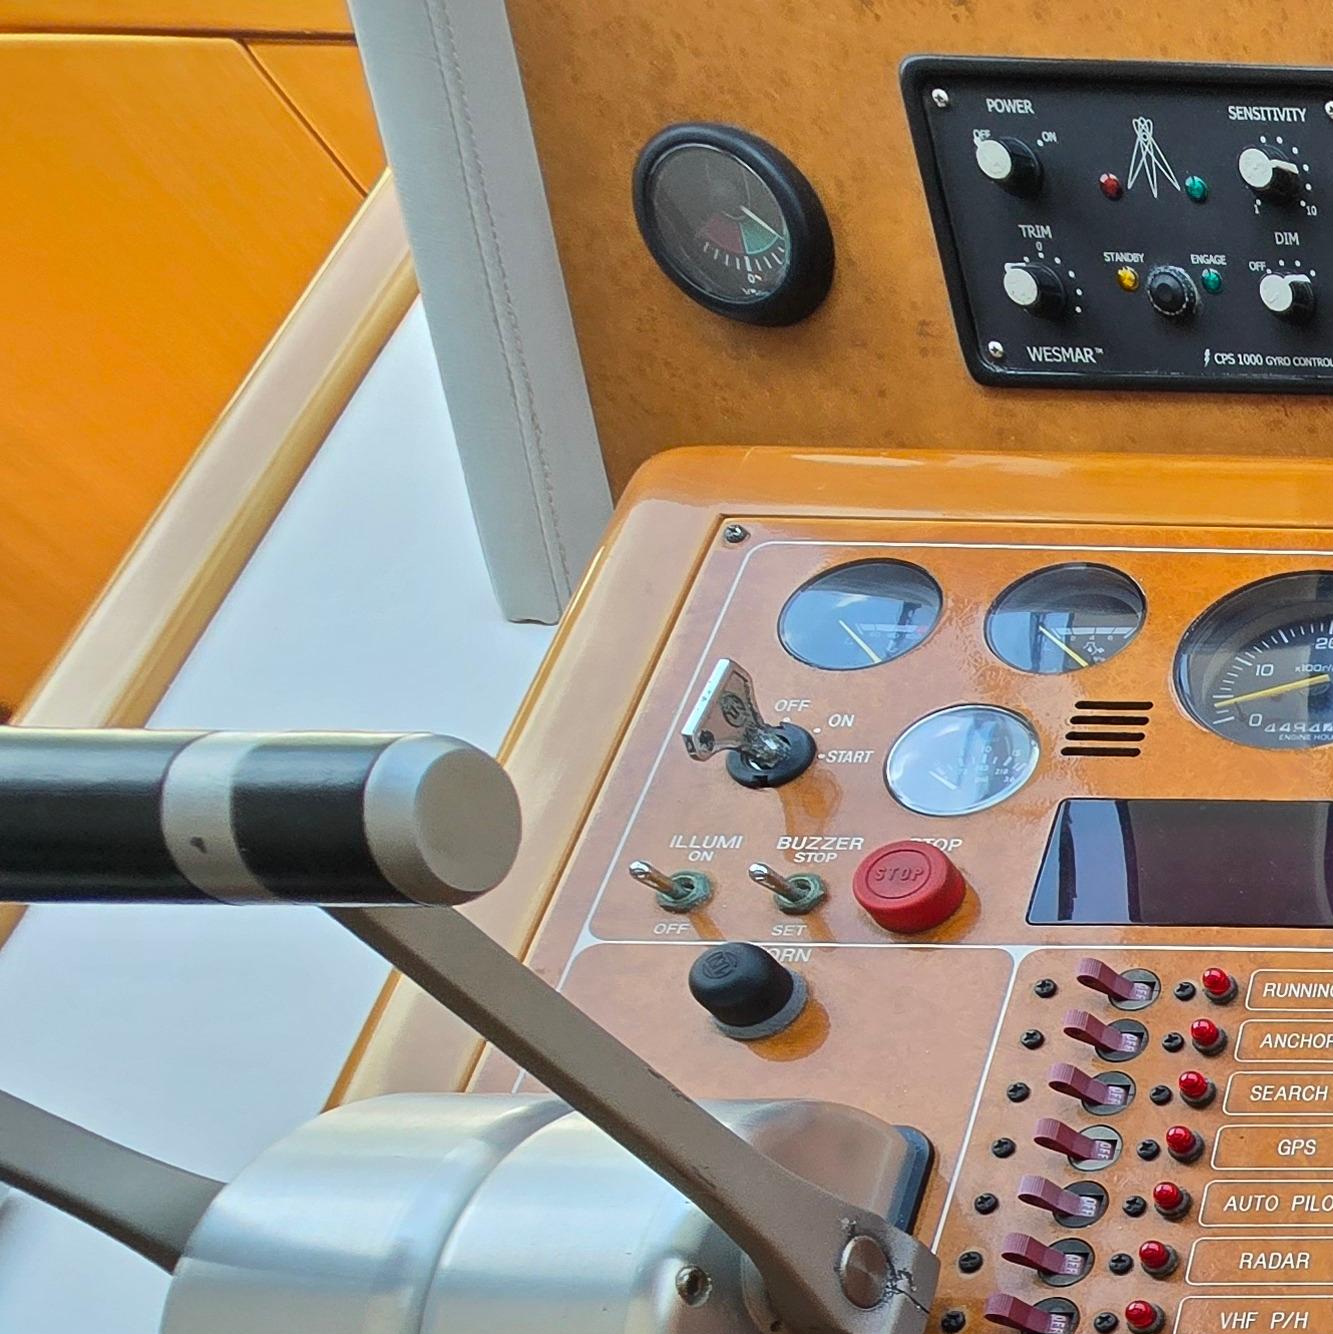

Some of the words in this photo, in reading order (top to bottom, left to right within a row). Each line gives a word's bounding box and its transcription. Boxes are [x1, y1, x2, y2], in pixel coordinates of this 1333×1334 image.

[986, 98, 1035, 115] POWER
[1228, 106, 1306, 122] SENSITIVITY
[1041, 131, 1058, 144] ON
[1306, 205, 1317, 216] 10
[1018, 224, 1052, 239] TRIM
[1274, 232, 1299, 246] DIM
[1103, 251, 1144, 263] STANDBY
[1190, 254, 1227, 266] ENGAGE
[1248, 261, 1266, 272] OFF
[1214, 353, 1236, 365] CPS
[1237, 353, 1263, 366] 1000
[1265, 356, 1291, 367] GYRO
[1255, 664, 1274, 677] 10
[774, 700, 811, 712] OFF
[828, 714, 855, 727] ON
[826, 750, 874, 763] START
[669, 836, 743, 849] ILLUMI
[776, 837, 864, 850] BUZZER
[688, 851, 714, 862] ON
[793, 852, 838, 863] STOP
[875, 866, 924, 882] STOP
[653, 924, 690, 935] OFF
[771, 925, 807, 936] SET
[768, 948, 811, 962] ORN
[1250, 1085, 1327, 1101] SEARCH
[1277, 1139, 1316, 1156] GPS
[1223, 1195, 1279, 1212] AUTO
[1239, 1253, 1310, 1270] RADAR
[1220, 1312, 1257, 1329] VHF
[1271, 1312, 1309, 1329] P/H
